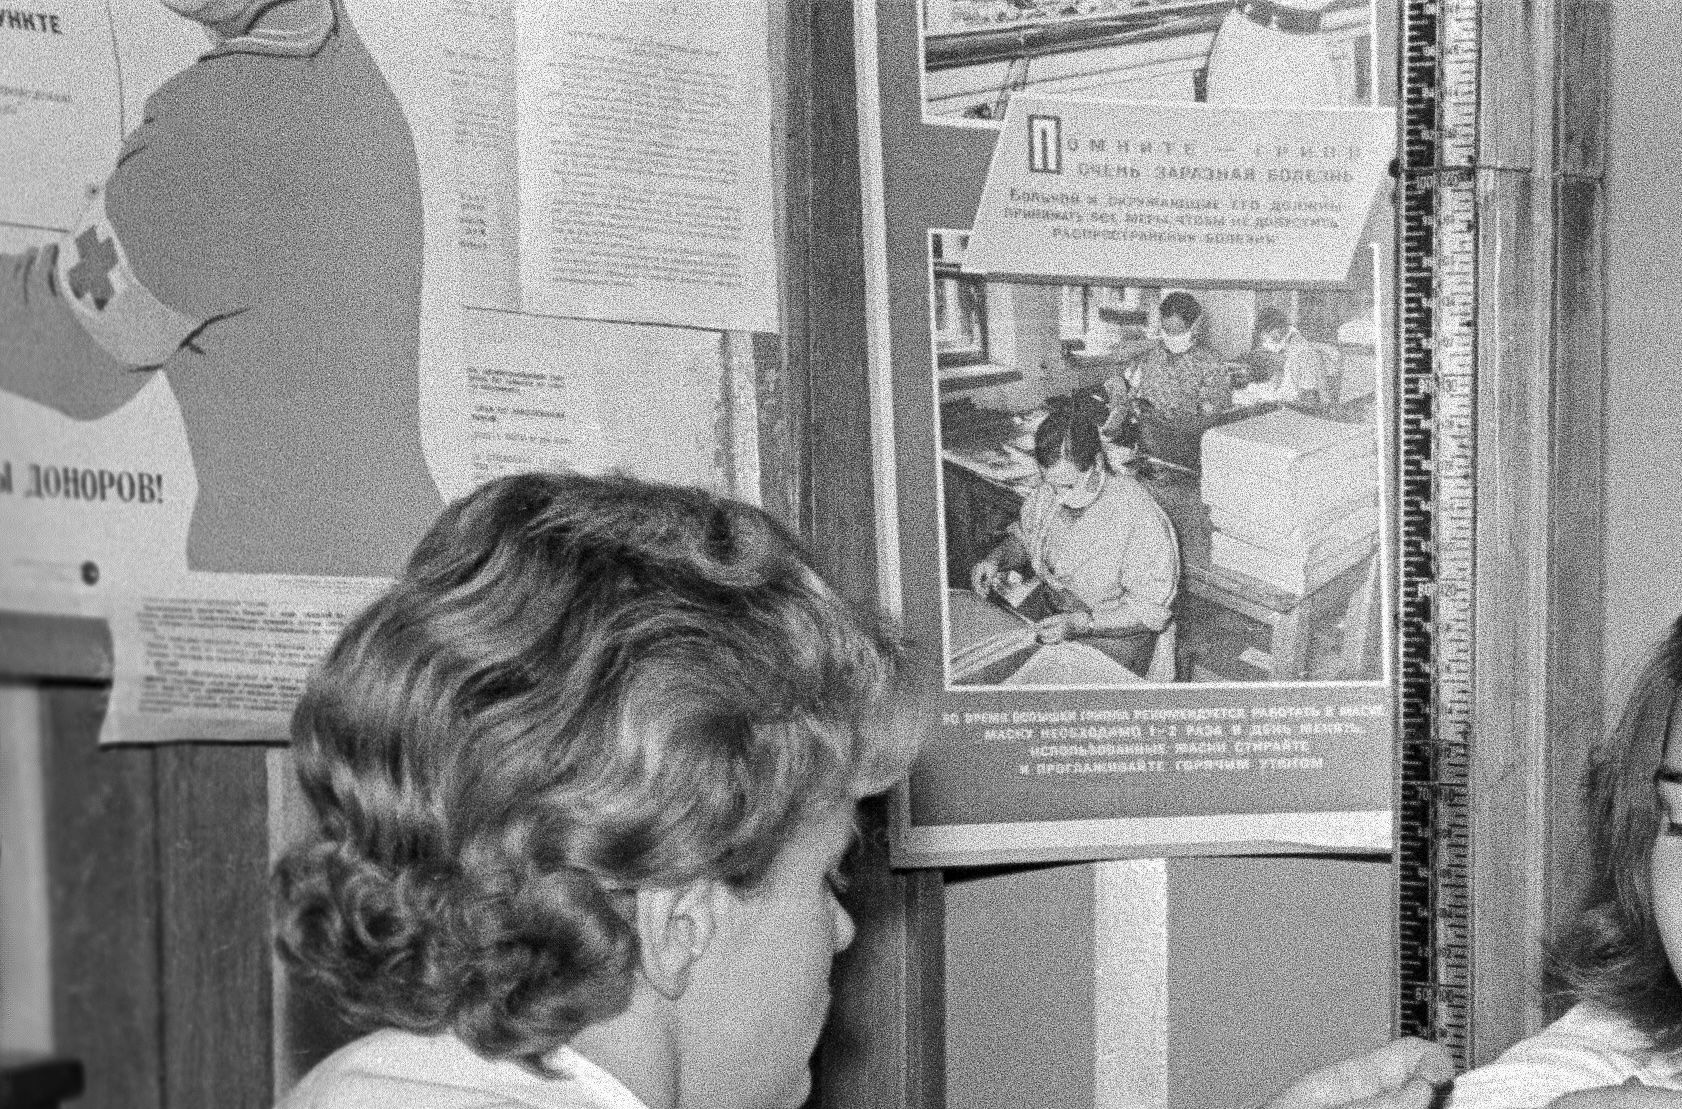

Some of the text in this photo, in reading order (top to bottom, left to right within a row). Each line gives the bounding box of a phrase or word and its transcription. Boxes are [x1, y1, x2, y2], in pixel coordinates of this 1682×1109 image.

[1078, 162, 1354, 184] ОЧЕНЬ ЗАРАЗНАЯ БОЛЕЗНЬ
[24, 463, 164, 504] ДОНОРОВ!
[984, 728, 1033, 741] МАСКУ
[1040, 725, 1140, 742] НЕОБХОДИМО
[1185, 724, 1223, 738] РАЗА
[1250, 722, 1292, 738] ДЕНЬ
[1175, 741, 1227, 754] МАСКИ
[1234, 738, 1310, 753] СТИРАЙТЕ
[1036, 759, 1165, 775] ПРОГЛАЖИВАЙТЕ
[1175, 757, 1250, 771] ГОРЯЧИМ
[1259, 755, 1324, 770] УТЮГОМ
